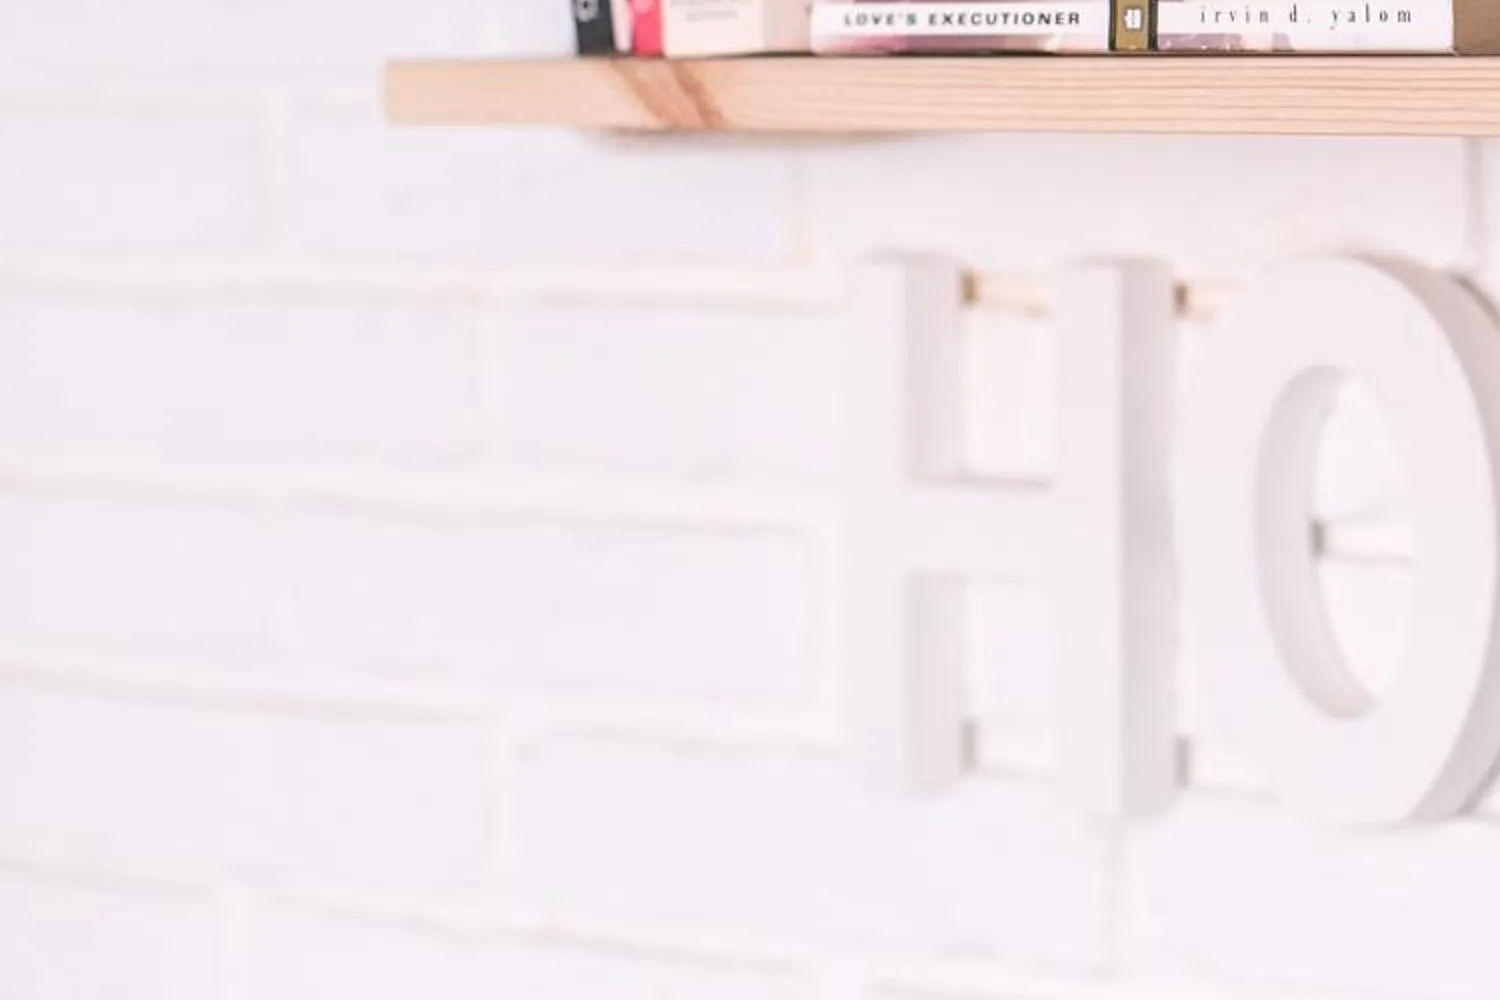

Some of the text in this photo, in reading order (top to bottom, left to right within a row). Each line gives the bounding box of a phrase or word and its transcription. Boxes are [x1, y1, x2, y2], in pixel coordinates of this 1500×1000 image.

[844, 11, 1081, 26] LOVE'S EXECUTIONER
[1200, 3, 1412, 30] irvin d. yalom
